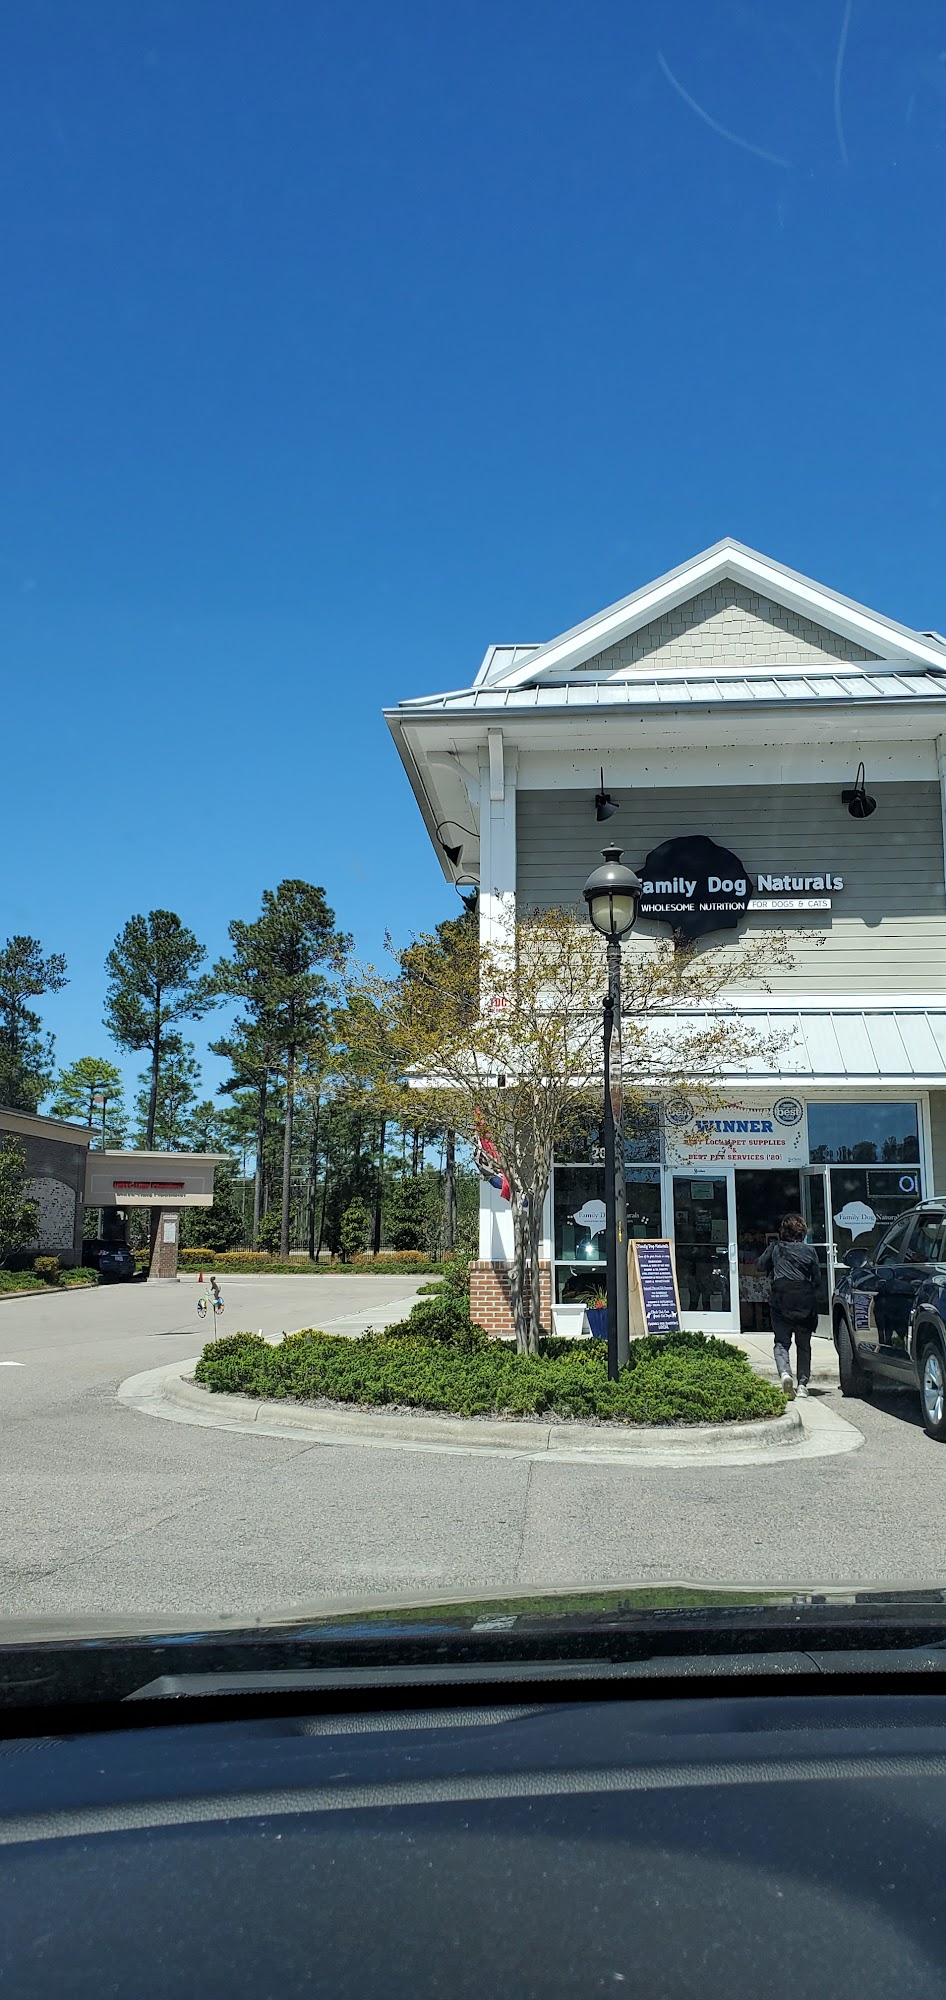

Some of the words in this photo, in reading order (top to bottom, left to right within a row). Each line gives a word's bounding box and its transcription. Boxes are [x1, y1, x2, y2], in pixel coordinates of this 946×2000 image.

[707, 876, 747, 897] Dog
[757, 873, 844, 892] Naturals
[641, 903, 696, 912] WHOLESOME
[699, 901, 746, 911] NUTRITION
[752, 900, 768, 908] FOR
[771, 900, 795, 908] DOGS
[798, 900, 804, 908] &
[807, 899, 828, 908] CATS
[776, 1106, 801, 1116] best
[695, 1119, 774, 1133] WINNER
[578, 1211, 599, 1219] Family
[839, 1213, 860, 1221] Family
[861, 1213, 875, 1221] Dog
[875, 1213, 900, 1221] Natural
